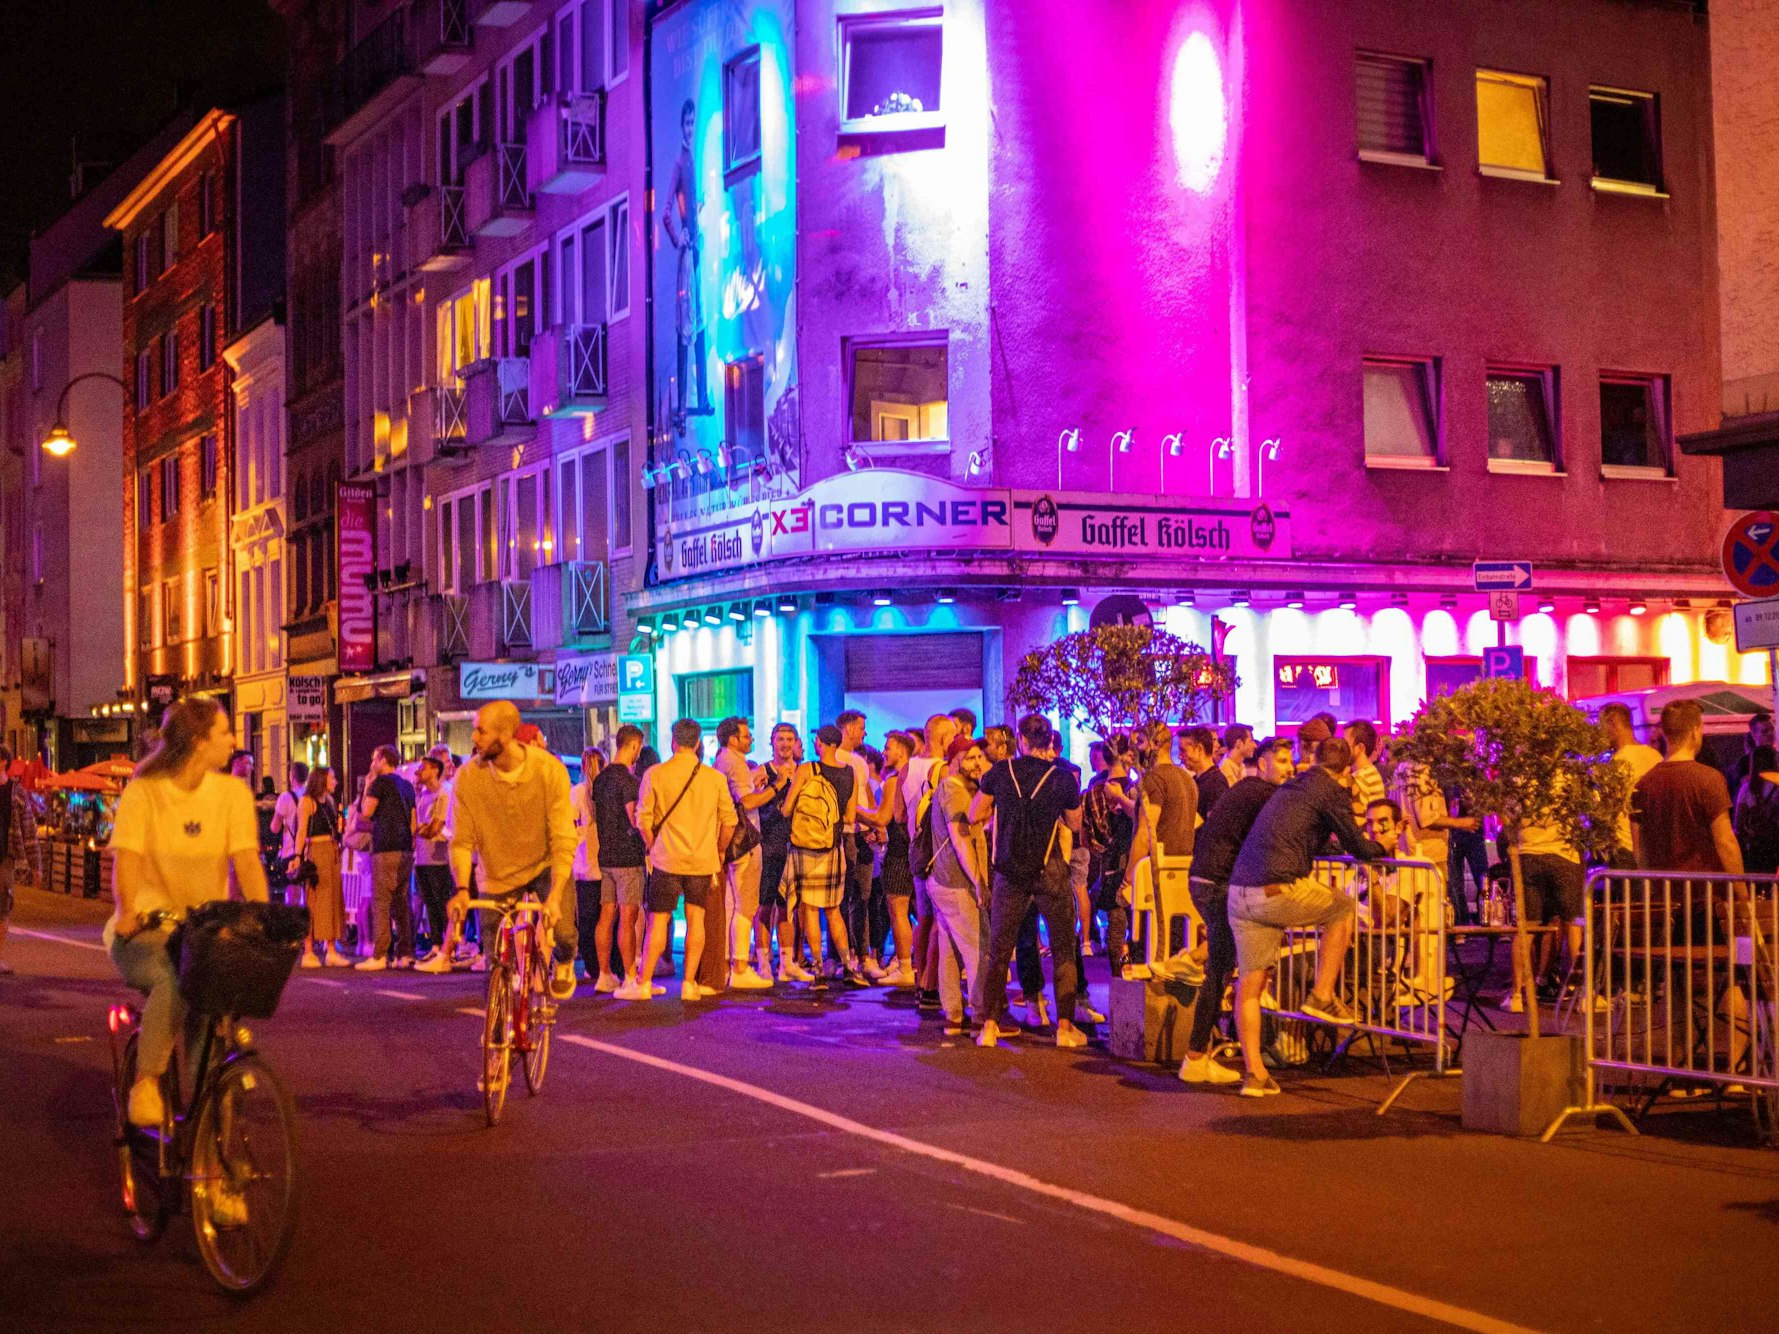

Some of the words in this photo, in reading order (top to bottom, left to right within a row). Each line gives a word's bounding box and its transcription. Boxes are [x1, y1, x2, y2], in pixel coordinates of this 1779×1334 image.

[819, 499, 1009, 529] CORNER
[1034, 514, 1056, 526] Gaffel
[1082, 515, 1148, 548] Gaffel
[1157, 513, 1230, 552] Kölsch
[681, 535, 707, 569] Gaffel
[711, 529, 742, 564] Kölsch
[626, 660, 644, 688] P
[1490, 651, 1511, 678] P
[297, 694, 308, 705] to
